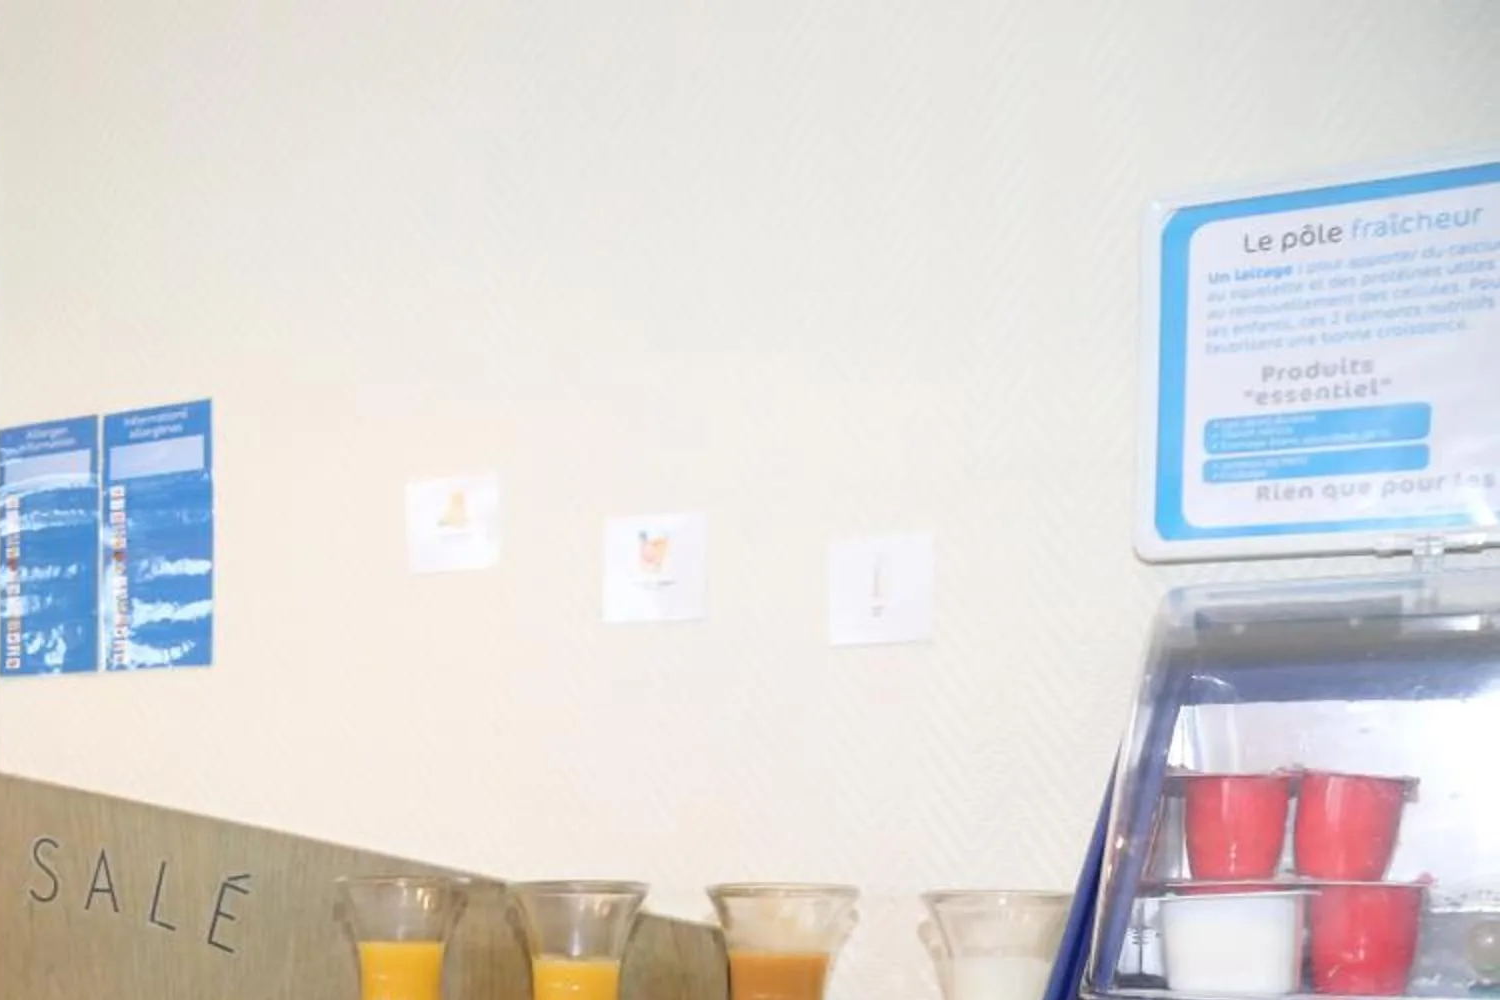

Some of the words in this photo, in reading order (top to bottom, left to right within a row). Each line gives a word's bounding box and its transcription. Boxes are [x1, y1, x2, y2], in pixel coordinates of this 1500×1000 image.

[1244, 232, 1274, 254] Le
[1280, 224, 1344, 253] pôle
[1351, 207, 1485, 240] fraîcheur
[1262, 357, 1376, 383] Produits
[1256, 482, 1314, 502] Rien
[1322, 480, 1372, 500] que
[1381, 473, 1446, 498] pour
[29, 837, 252, 954] SALÉ
